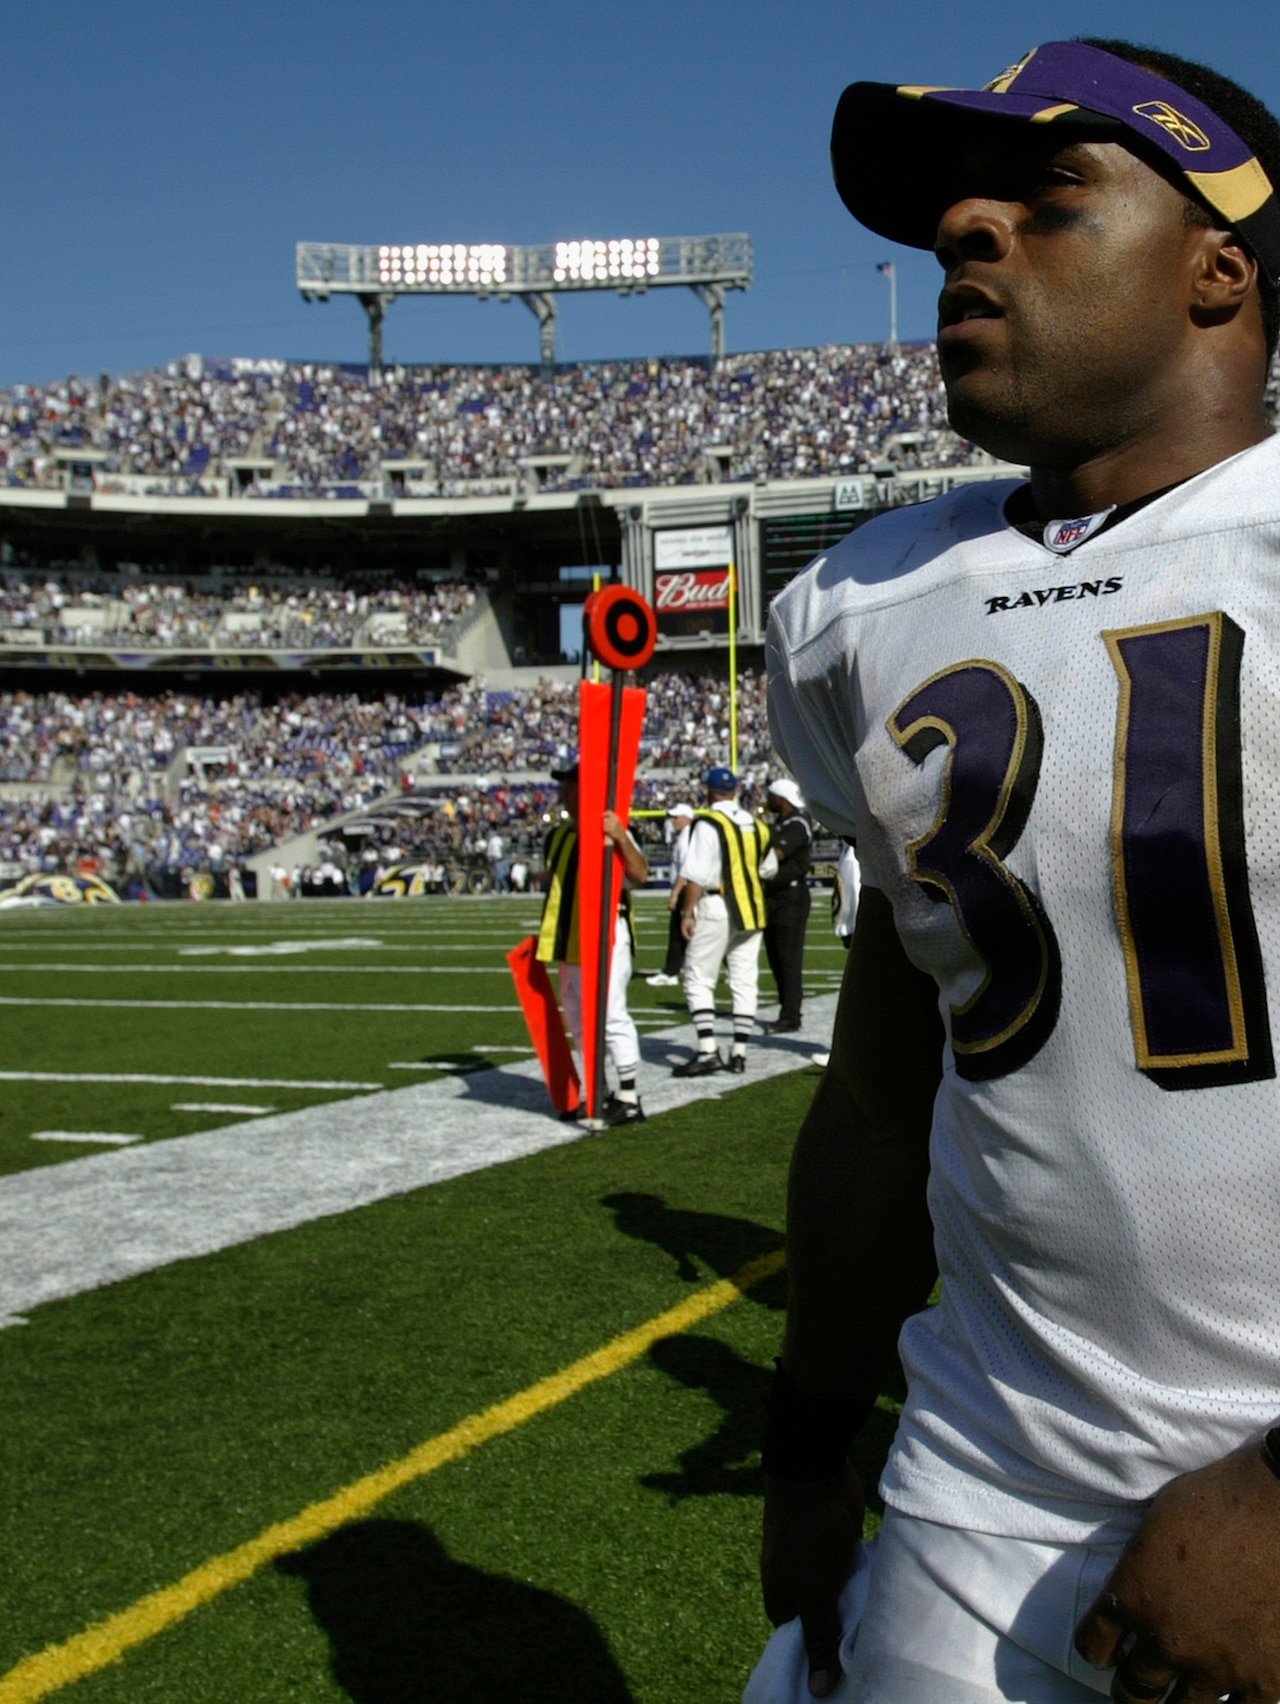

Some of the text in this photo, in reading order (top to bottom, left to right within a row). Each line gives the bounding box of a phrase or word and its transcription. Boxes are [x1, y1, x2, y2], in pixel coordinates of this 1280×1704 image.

[655, 573, 732, 609] Bud
[984, 576, 1125, 616] RAVENS
[885, 611, 1277, 1092] 31
